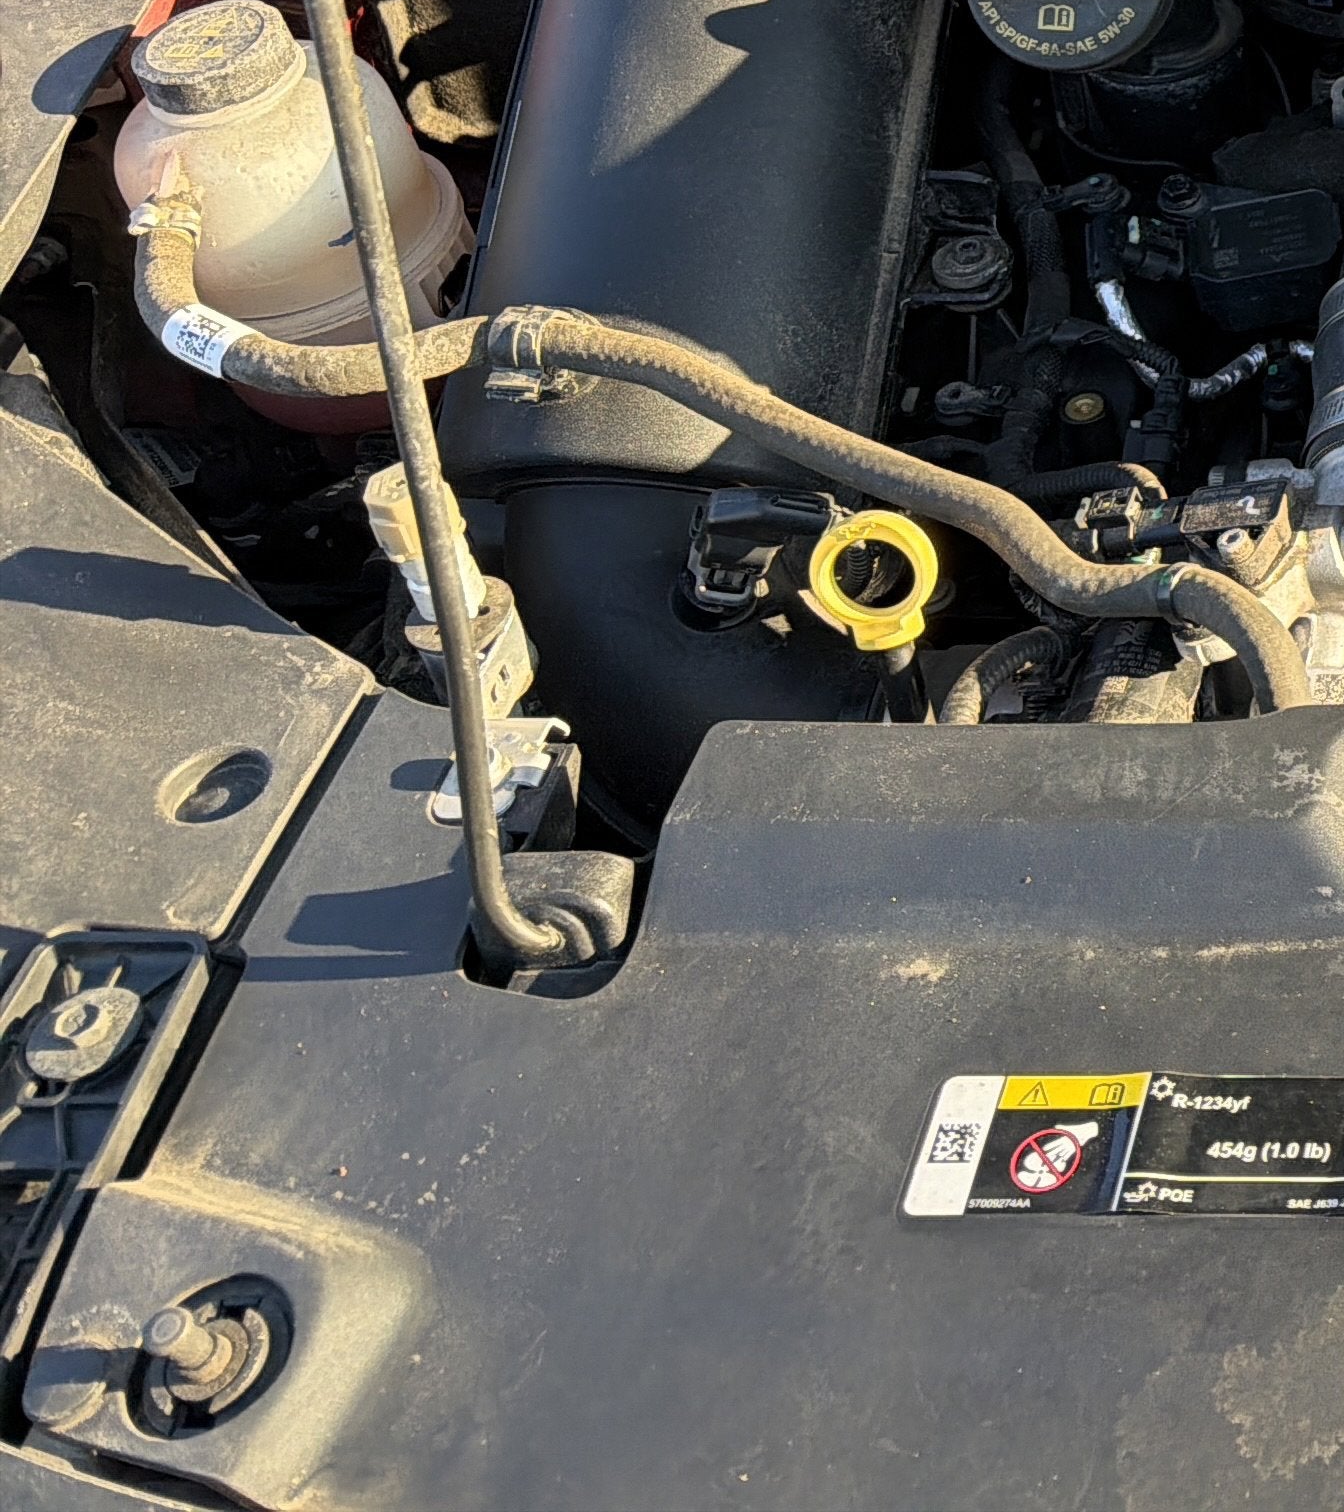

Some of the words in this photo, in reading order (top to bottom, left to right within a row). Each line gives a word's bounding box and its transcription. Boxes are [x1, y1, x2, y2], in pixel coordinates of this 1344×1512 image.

[978, 0, 1000, 25] API
[1099, 6, 1136, 45] 5W-30
[1171, 1093, 1251, 1114] R-1234yf
[1206, 1141, 1258, 1163] 454g
[1261, 1141, 1299, 1163] (1.0
[1303, 1141, 1332, 1163] lb)
[1158, 1188, 1195, 1203] POE
[1286, 1198, 1312, 1209] SAE
